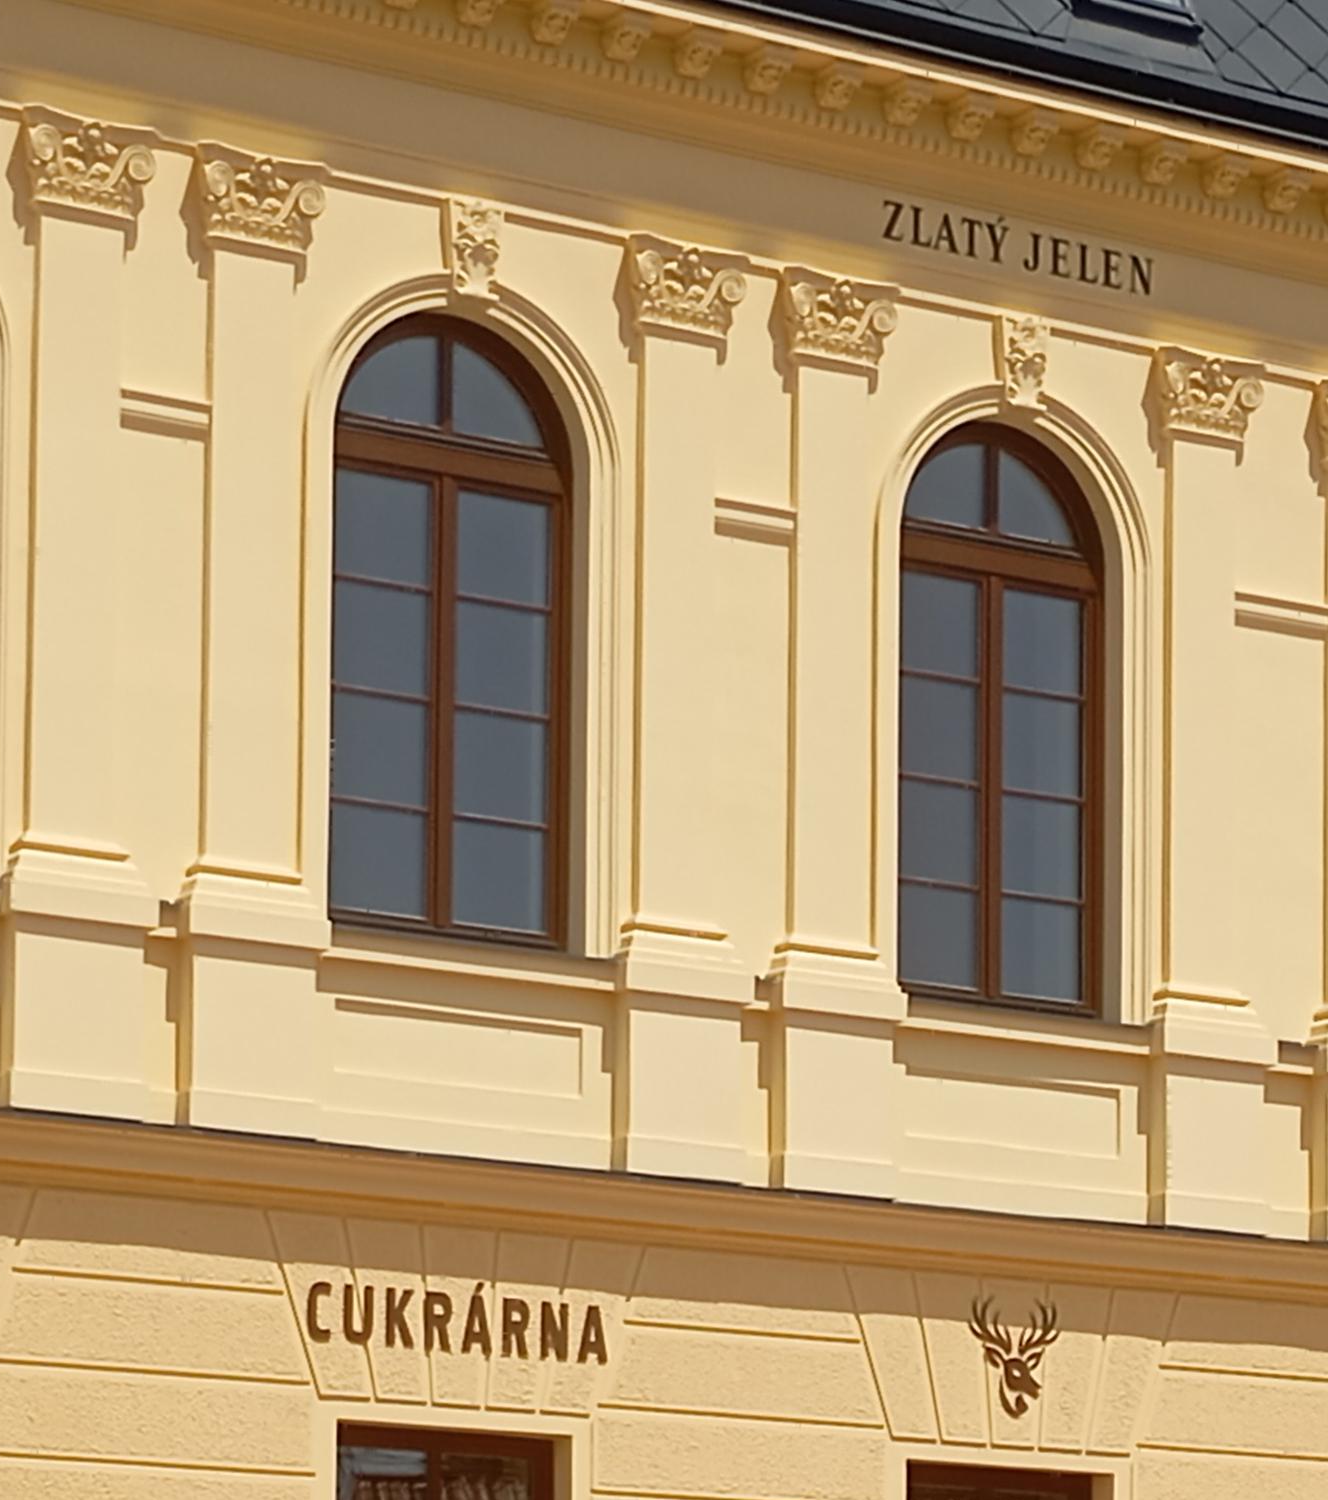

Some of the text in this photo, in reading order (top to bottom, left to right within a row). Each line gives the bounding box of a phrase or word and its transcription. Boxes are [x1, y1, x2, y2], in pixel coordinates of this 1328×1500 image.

[881, 200, 1155, 296] ZLATÝ JELEN
[307, 1281, 608, 1365] CUKRÁRNA
